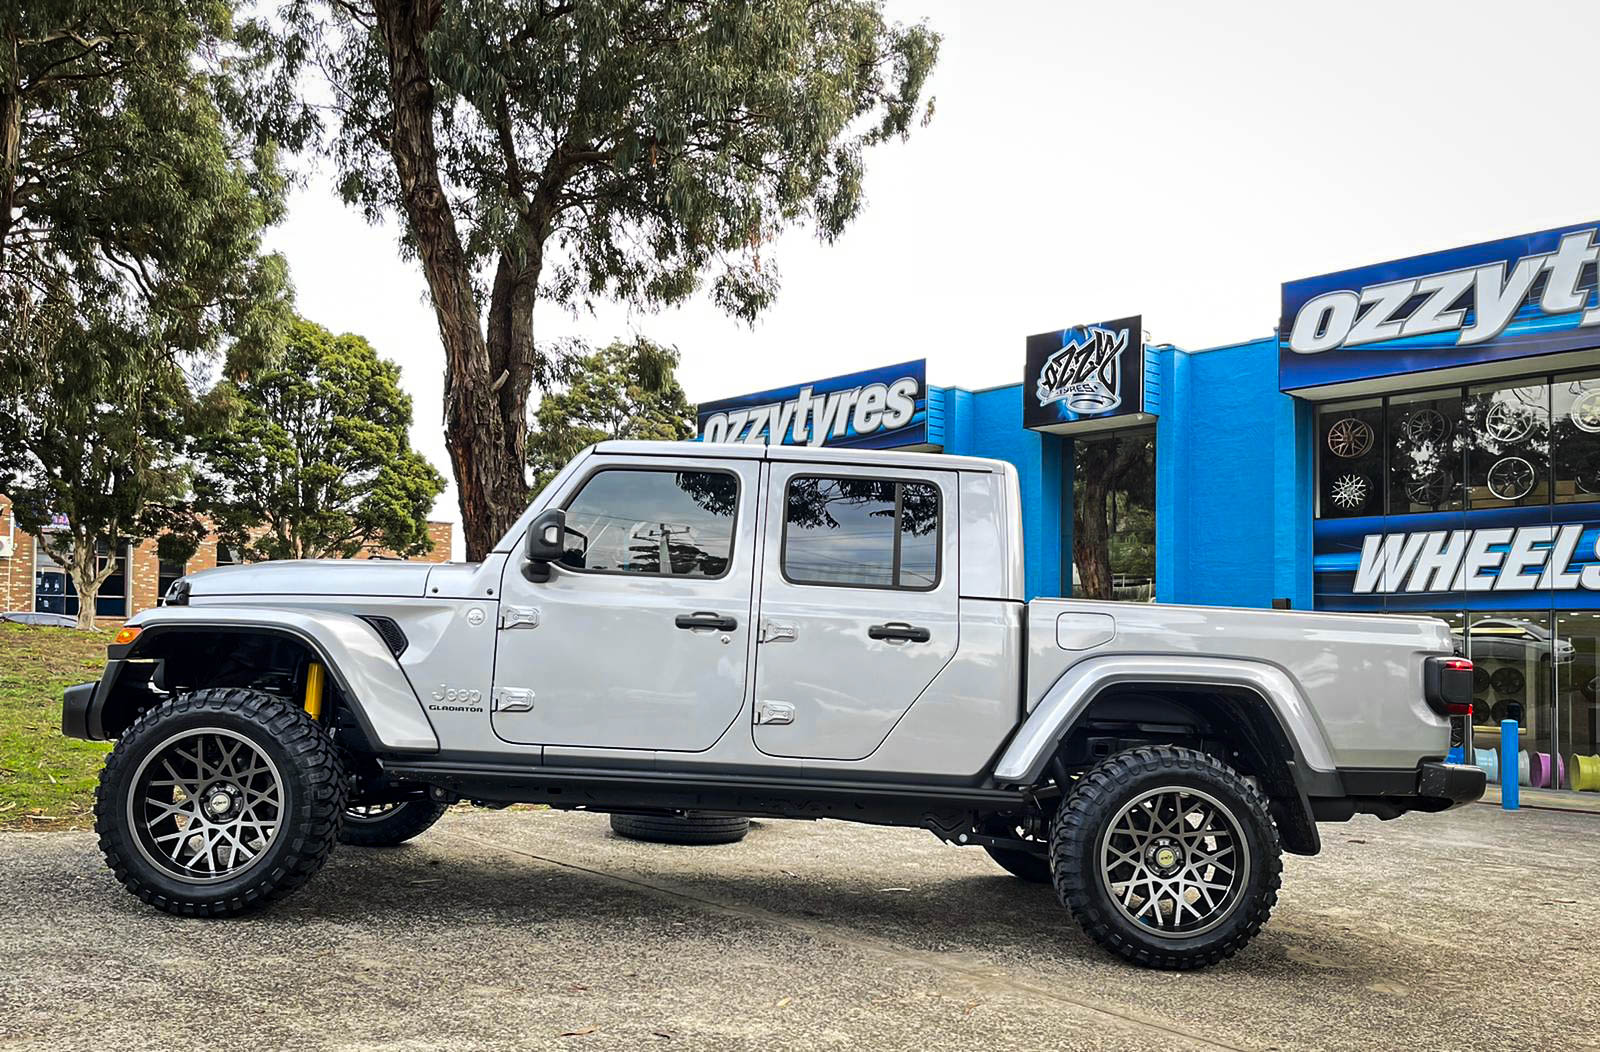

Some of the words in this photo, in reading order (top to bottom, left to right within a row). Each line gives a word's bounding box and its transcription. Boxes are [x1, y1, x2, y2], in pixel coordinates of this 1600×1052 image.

[1289, 227, 1600, 354] ozzyt
[703, 376, 919, 447] ozzytyres
[428, 704, 484, 713] GLADIATOR
[431, 683, 482, 706] Jeep
